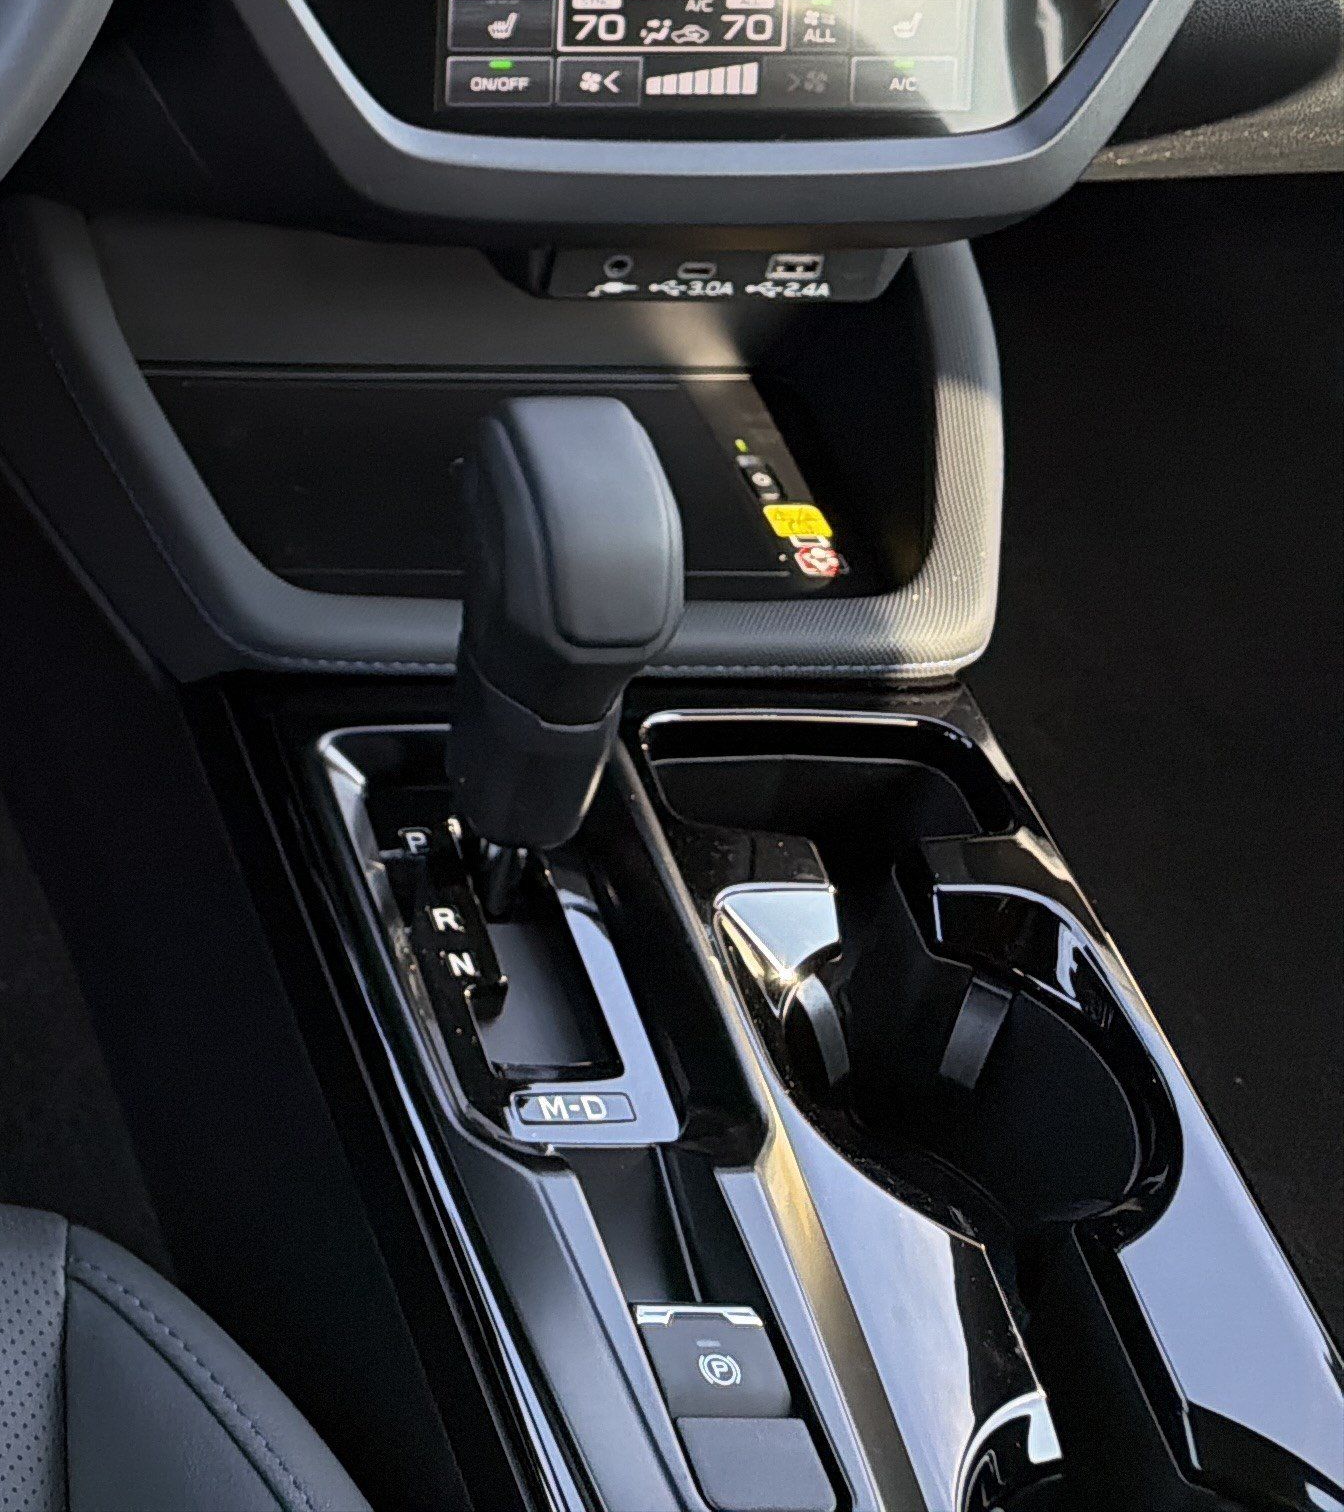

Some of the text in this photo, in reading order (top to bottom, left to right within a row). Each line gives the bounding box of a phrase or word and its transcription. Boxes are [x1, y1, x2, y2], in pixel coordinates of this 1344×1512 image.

[572, 13, 626, 41] 70
[719, 13, 774, 41] 70
[803, 28, 837, 44] ALL
[469, 76, 530, 92] ON/OFF
[889, 76, 918, 92] A/C
[783, 281, 831, 298] 2.4A
[405, 831, 428, 855] P
[431, 906, 459, 932] R
[447, 952, 476, 977] N
[538, 1095, 607, 1121] M-D
